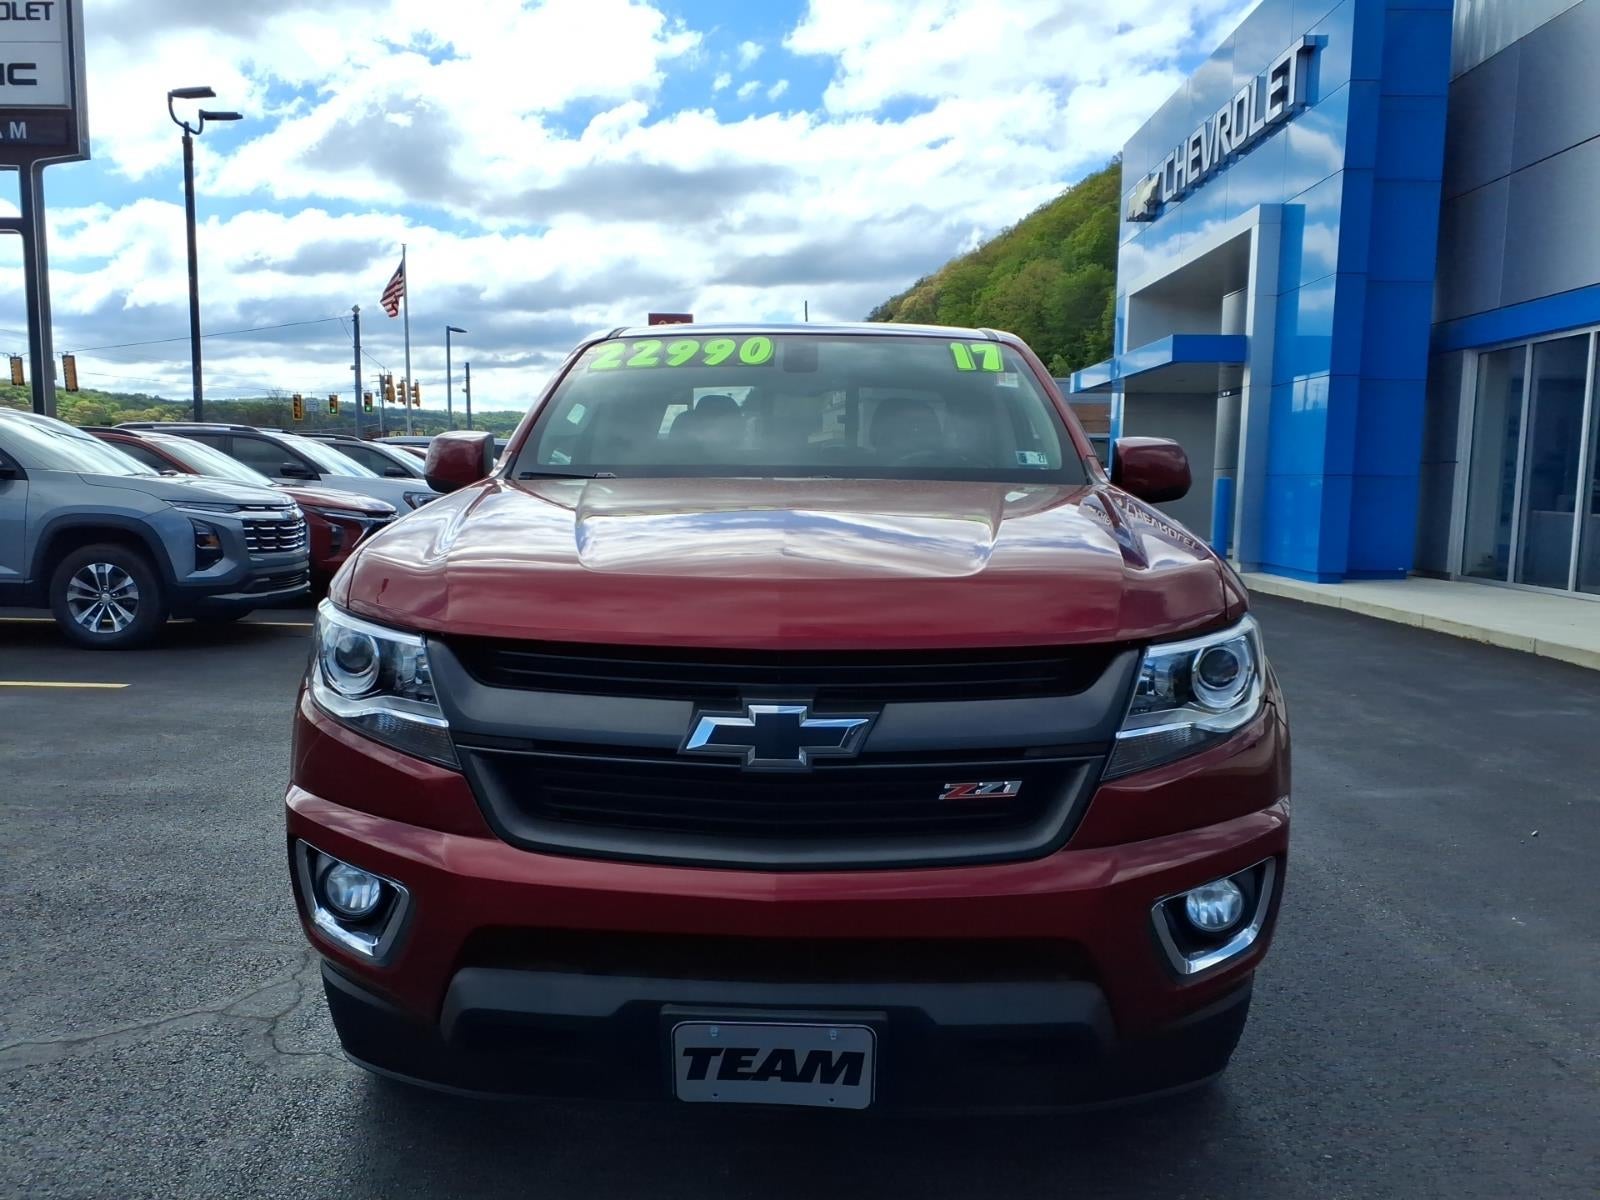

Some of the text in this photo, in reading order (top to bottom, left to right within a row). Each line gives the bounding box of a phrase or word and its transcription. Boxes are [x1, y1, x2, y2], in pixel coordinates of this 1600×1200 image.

[0, 63, 38, 86] C
[0, 121, 27, 139] M
[1162, 35, 1306, 203] CHEVROLET
[589, 337, 772, 369] 22990
[950, 342, 1004, 371] 17
[939, 781, 1022, 800] Z71
[682, 1047, 865, 1086] TEAM
